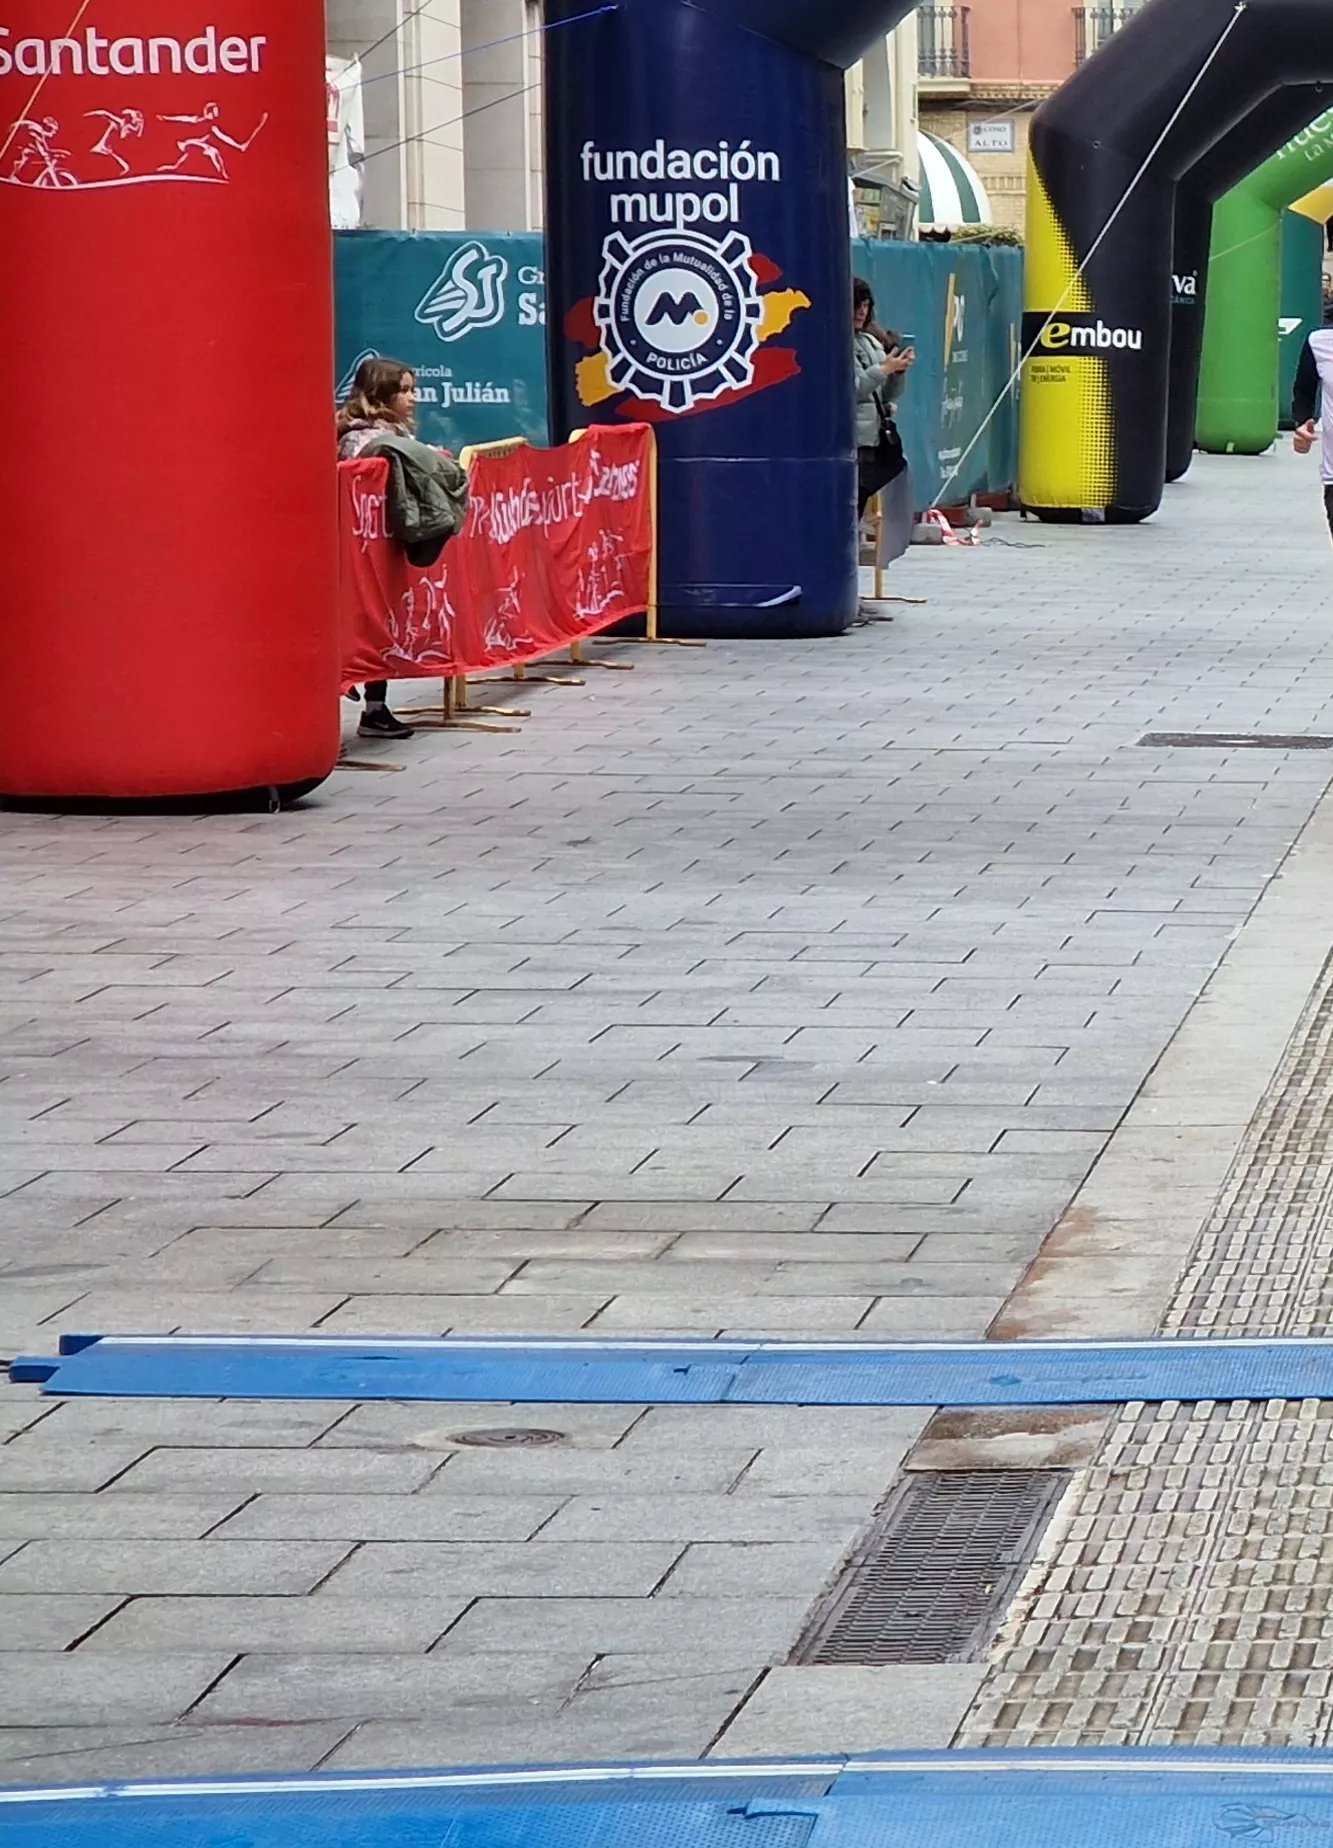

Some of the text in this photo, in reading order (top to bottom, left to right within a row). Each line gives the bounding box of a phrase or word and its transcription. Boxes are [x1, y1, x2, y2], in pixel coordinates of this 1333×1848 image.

[0, 25, 267, 76] Santander
[580, 139, 780, 181] fundación
[610, 183, 738, 229] mupol
[620, 266, 645, 322] Fundación
[644, 258, 658, 270] de
[658, 254, 670, 264] la
[673, 252, 728, 291] Mutualidad
[721, 292, 733, 306] de
[1041, 319, 1142, 350] embou
[412, 364, 453, 378] rícola
[646, 352, 708, 370] POLICÍA
[413, 381, 511, 408] an Julián
